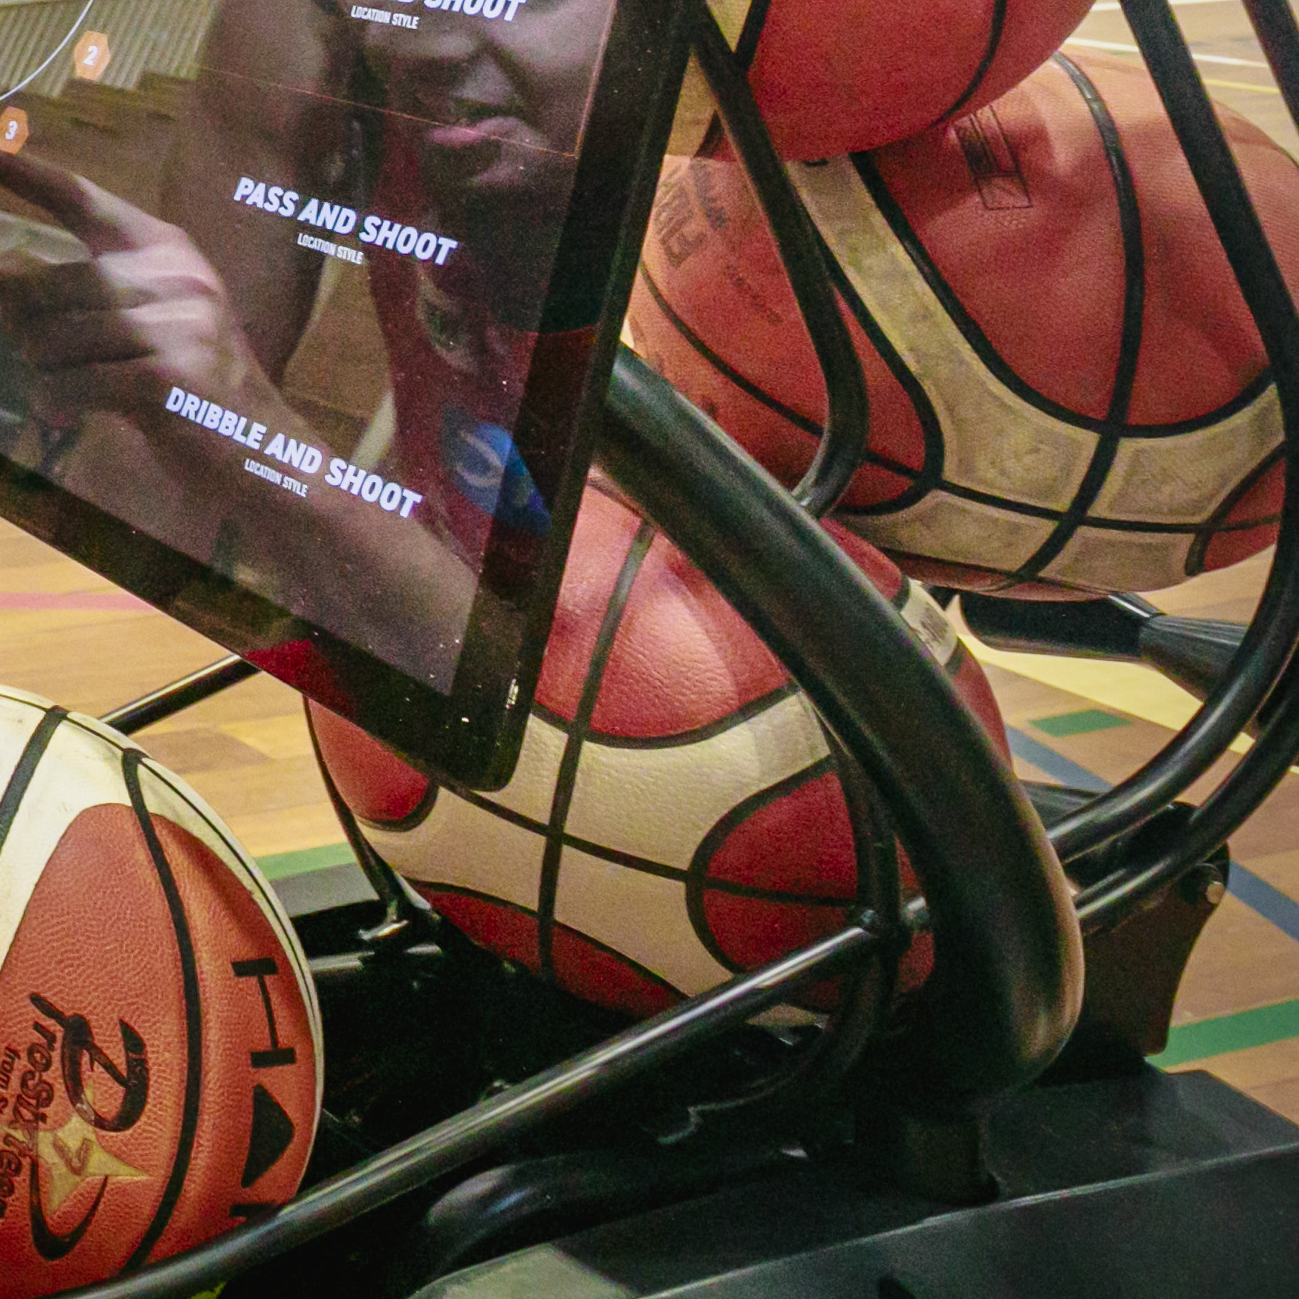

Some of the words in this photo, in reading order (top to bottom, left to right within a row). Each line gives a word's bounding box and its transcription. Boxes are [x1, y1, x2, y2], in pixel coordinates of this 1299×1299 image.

[351, 5, 391, 24] LOCATION
[391, 11, 420, 30] STYLE
[83, 45, 99, 66] 2
[5, 120, 19, 141] 3
[233, 176, 299, 218] PASS
[296, 198, 358, 235] AND
[358, 216, 459, 266] SHOOT
[297, 232, 337, 258] LOCATION
[336, 244, 364, 265] STYLE
[164, 386, 268, 450] DRIBBLE
[263, 432, 324, 476] AND
[323, 458, 423, 518] SHOOT
[244, 458, 282, 485] LOCATION
[281, 476, 309, 498] STYLE
